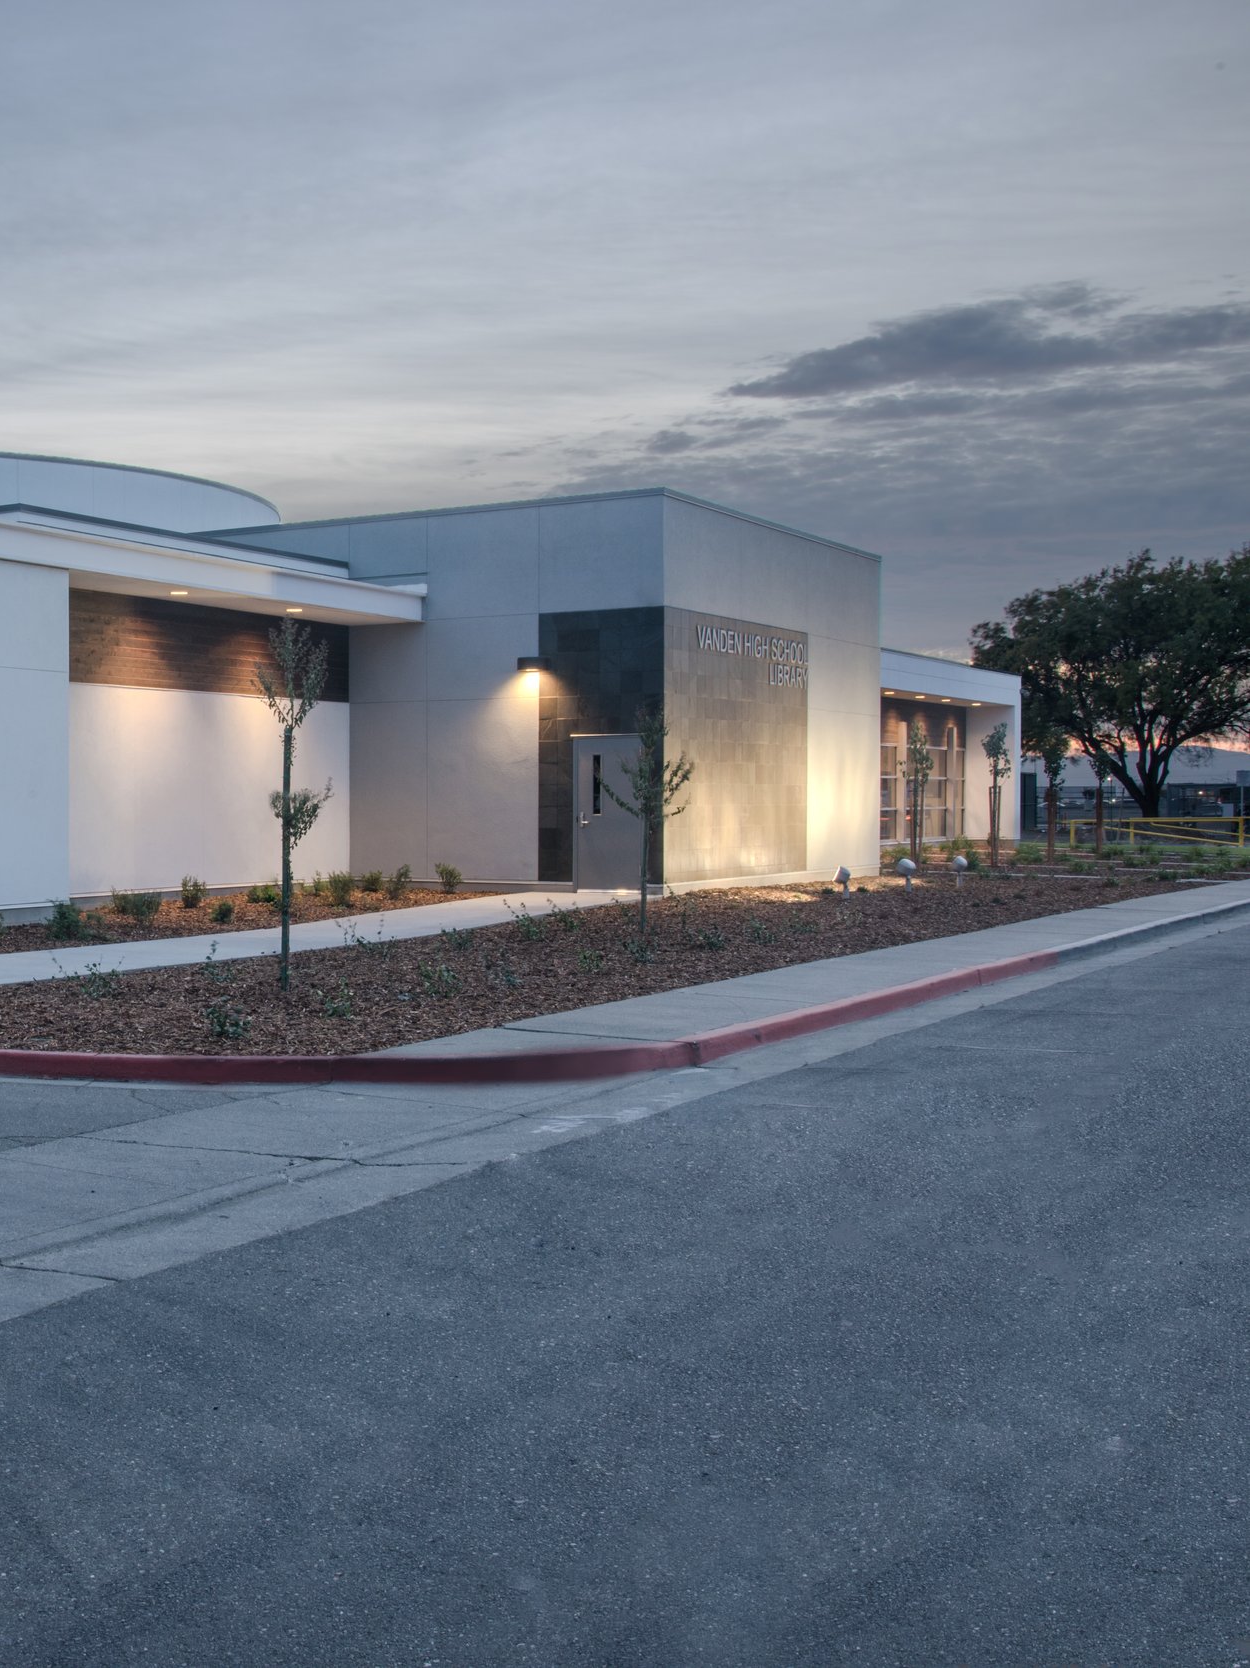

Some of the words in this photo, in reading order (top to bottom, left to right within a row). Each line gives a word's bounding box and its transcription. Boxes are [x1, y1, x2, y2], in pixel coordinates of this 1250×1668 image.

[696, 625, 742, 655] VANDEN
[744, 634, 769, 659] HIGH
[771, 637, 809, 665] SCHOOL
[768, 663, 809, 690] LIBRARY
